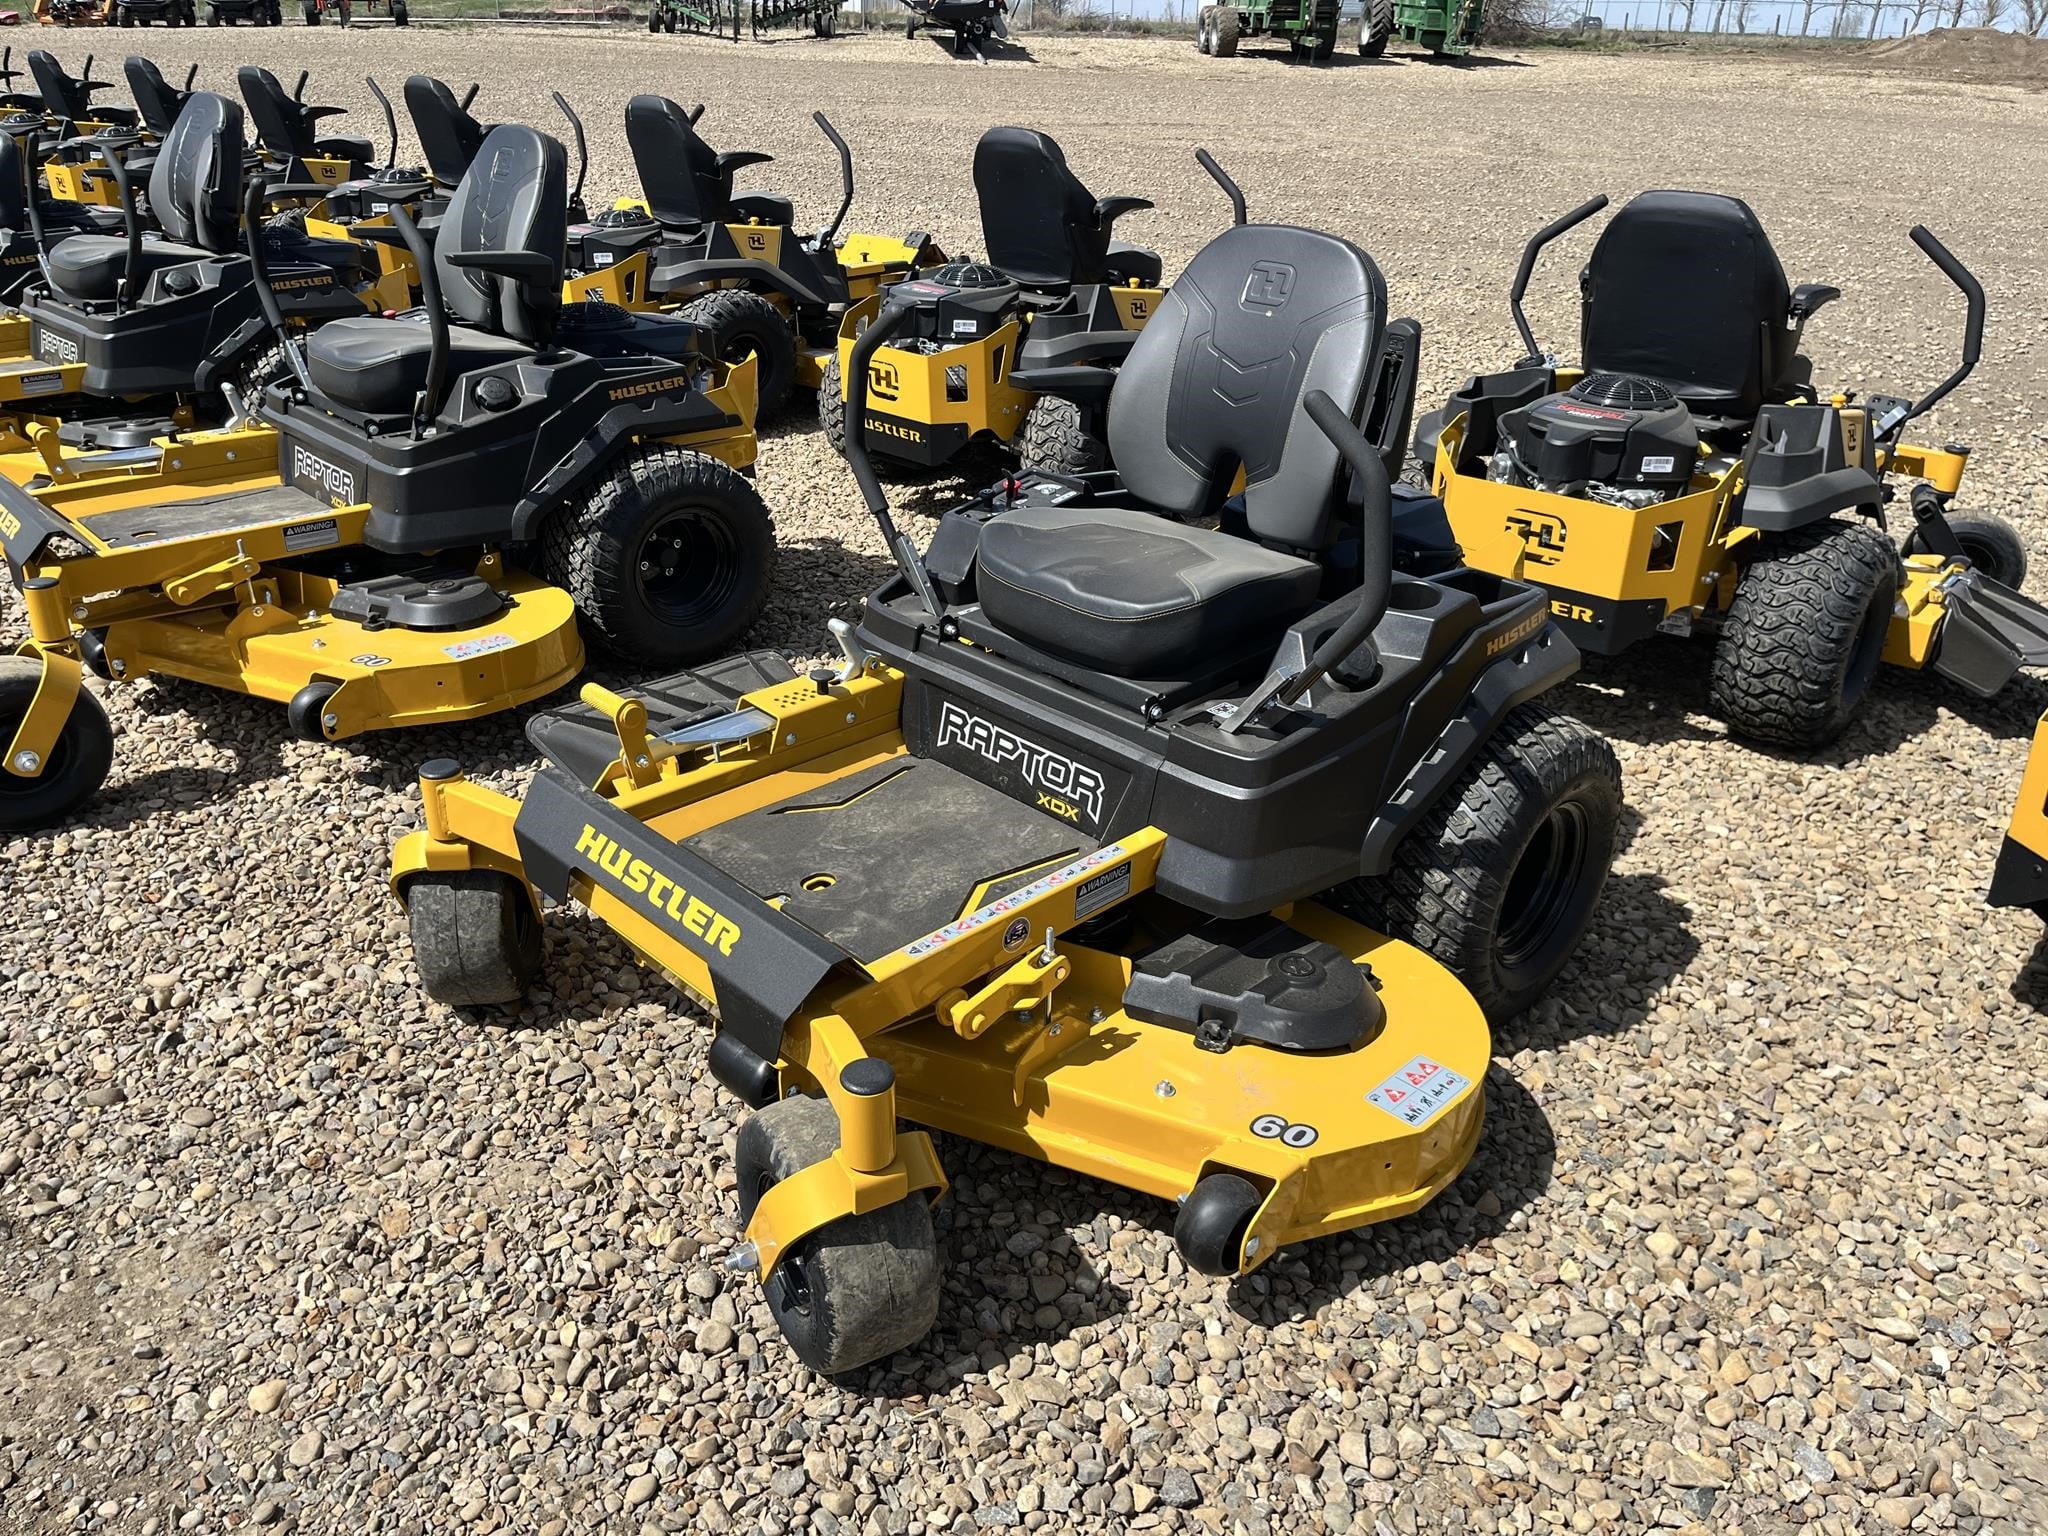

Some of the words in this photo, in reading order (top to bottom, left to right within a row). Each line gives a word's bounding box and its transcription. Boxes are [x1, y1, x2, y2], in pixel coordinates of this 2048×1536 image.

[271, 276, 332, 290] HUSTLER
[41, 328, 78, 364] RAPTOR
[609, 376, 685, 401] HUSTLER
[865, 418, 921, 442] USTLER
[294, 445, 354, 507] RAPTOR
[1486, 607, 1547, 657] HUSTLER
[350, 654, 392, 668] 60
[936, 701, 1106, 825] RAPTOR
[1036, 791, 1081, 823] XDX
[574, 823, 742, 957] HUSTLER
[1087, 863, 1129, 893] WARNING!
[1249, 1113, 1319, 1149] 60
